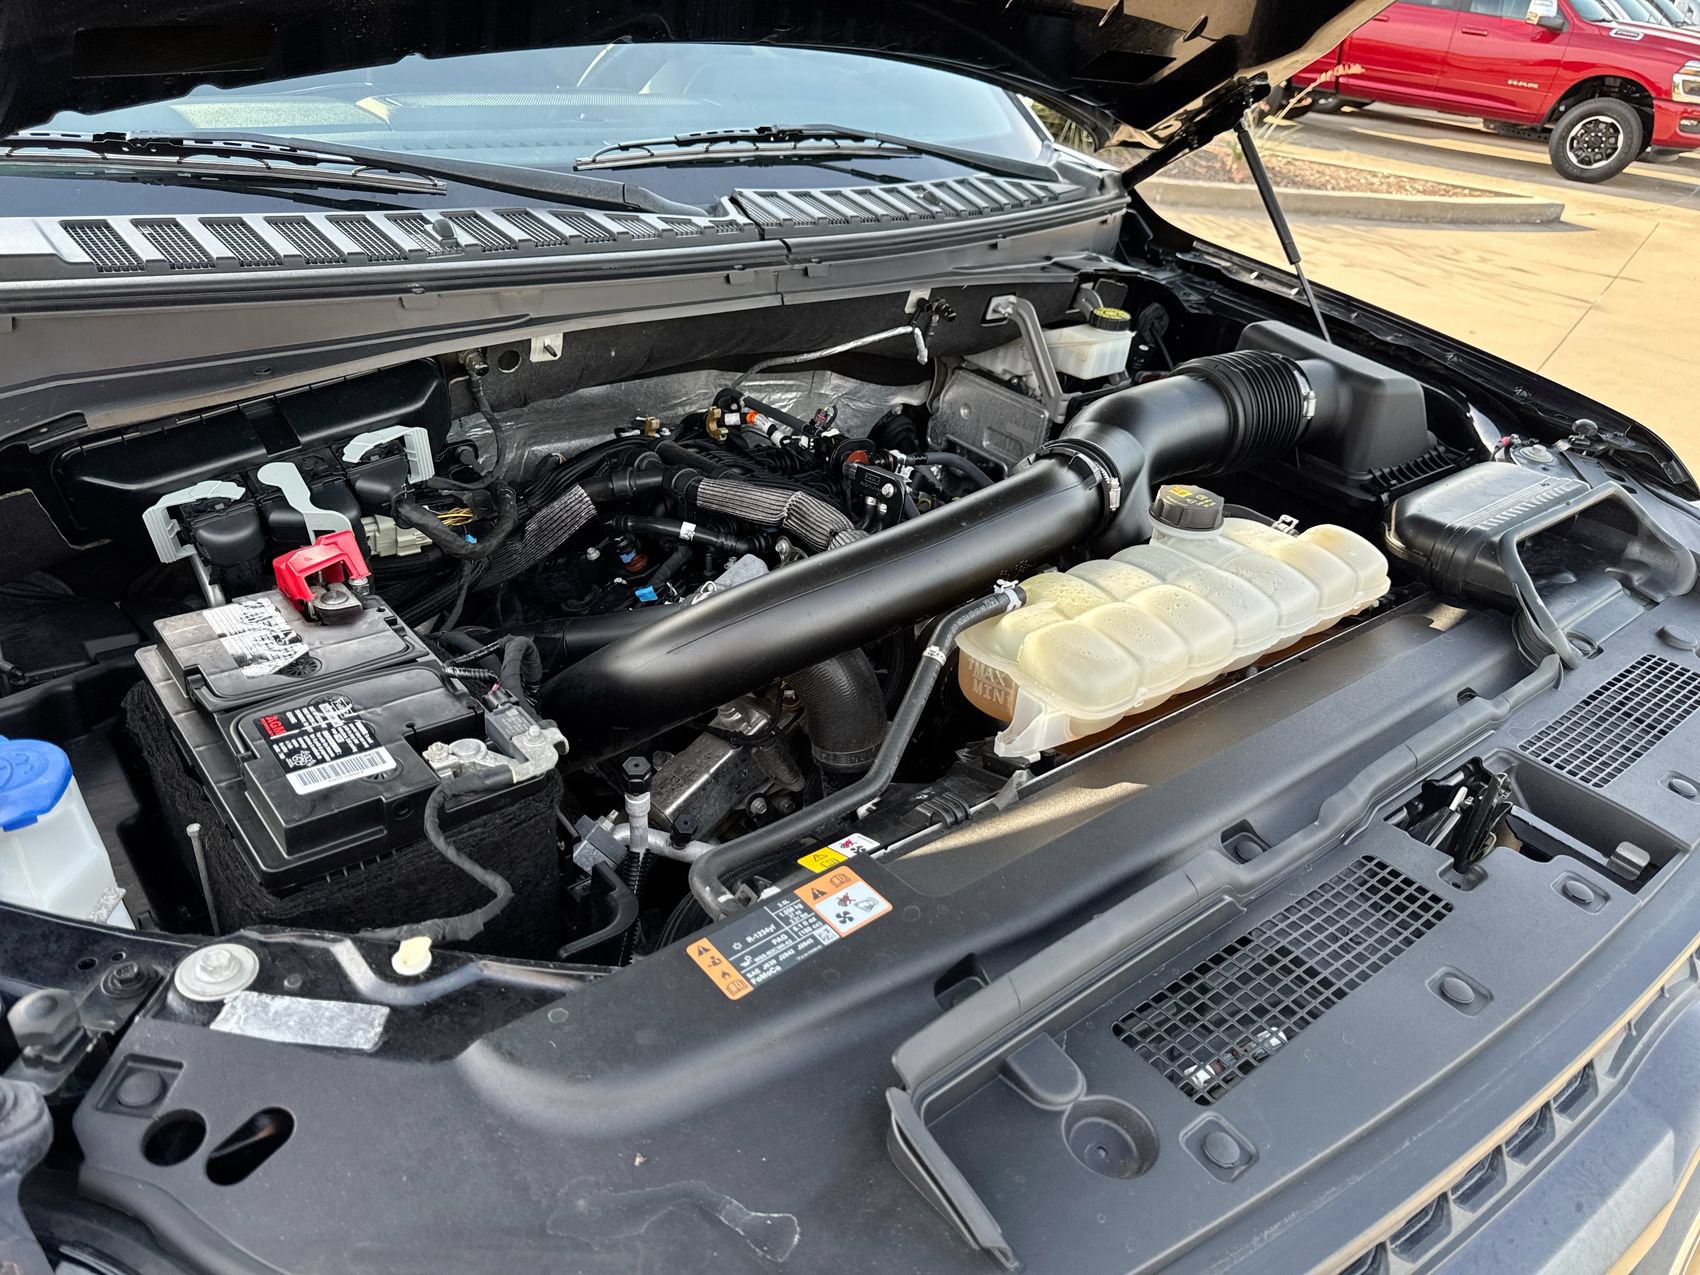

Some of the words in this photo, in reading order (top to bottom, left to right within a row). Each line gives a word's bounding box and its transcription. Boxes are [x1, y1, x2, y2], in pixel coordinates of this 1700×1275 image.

[973, 661, 1007, 687] MAX
[972, 678, 1005, 705] MIN
[264, 714, 287, 735] AGM
[745, 923, 777, 944] R-1234yf
[771, 933, 789, 946] PAG
[746, 967, 761, 980] SAE
[750, 964, 783, 985] FoMoCo
